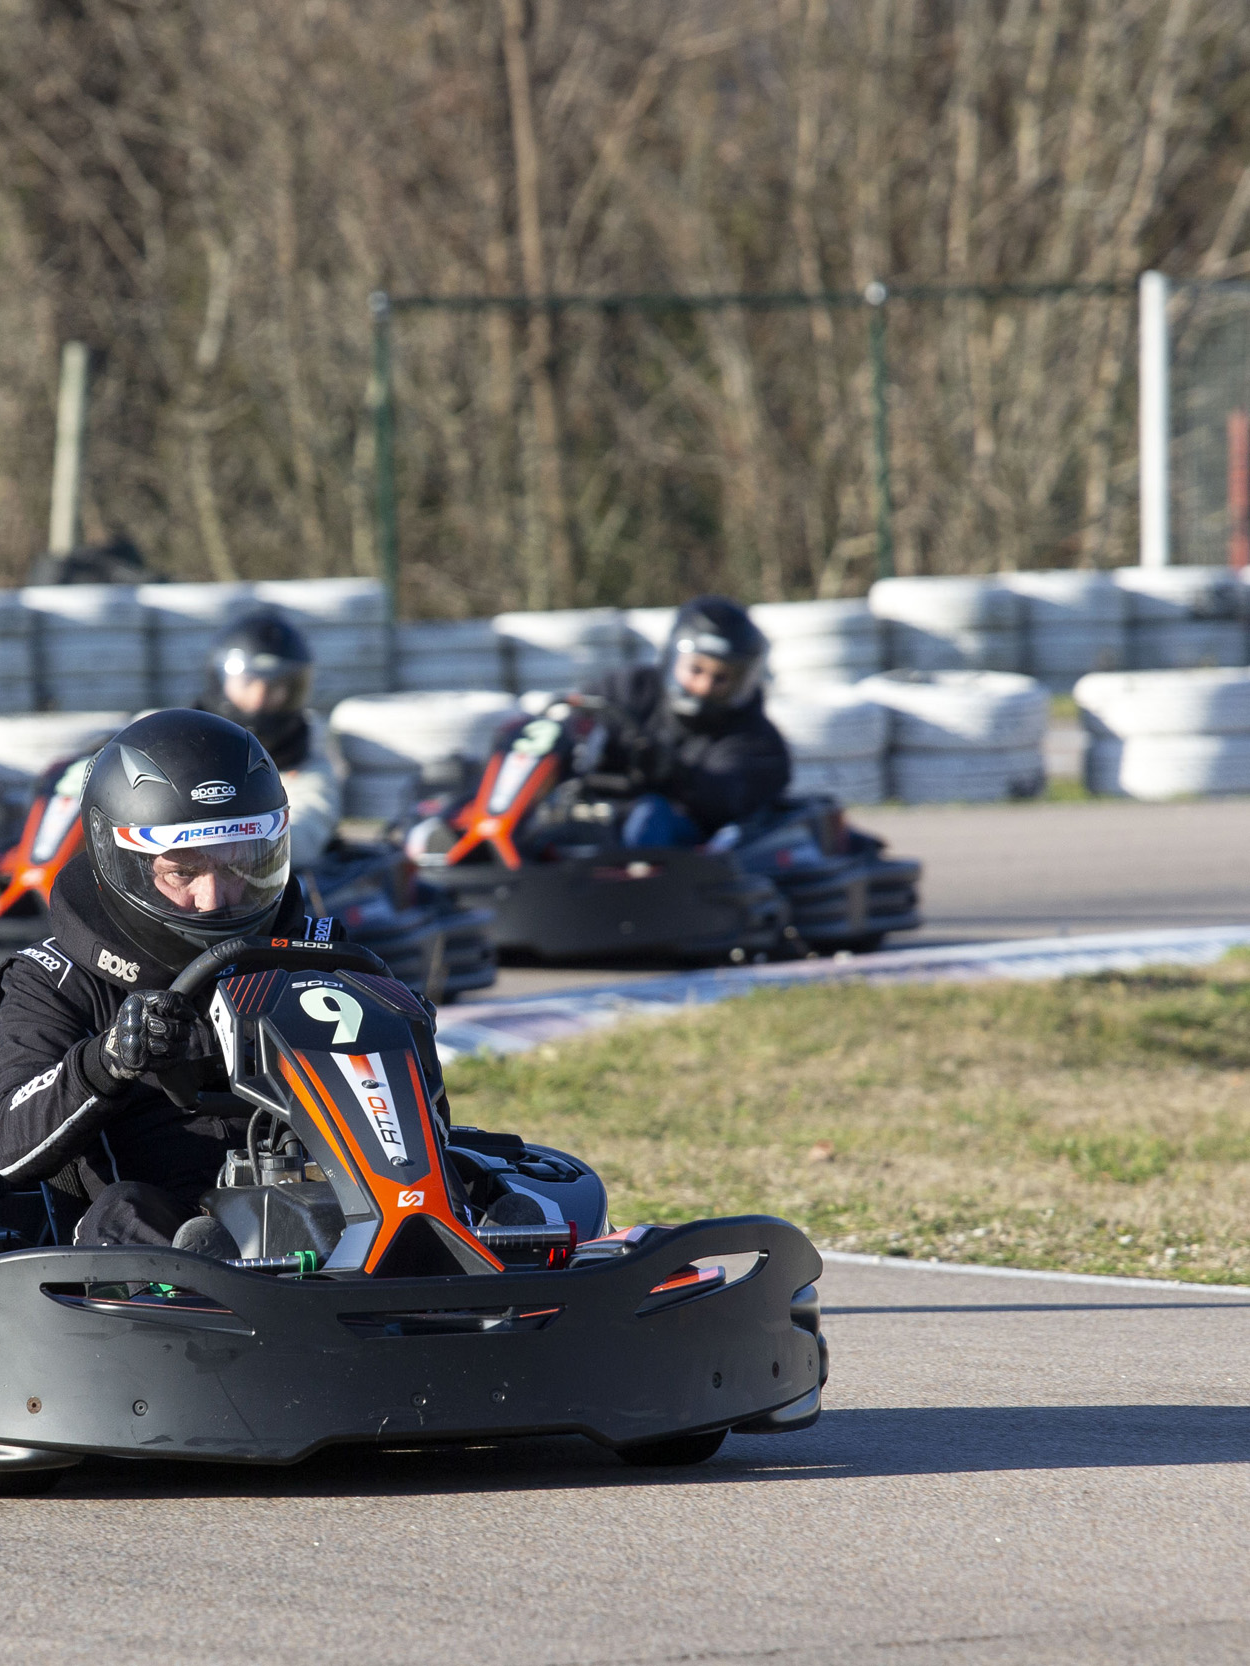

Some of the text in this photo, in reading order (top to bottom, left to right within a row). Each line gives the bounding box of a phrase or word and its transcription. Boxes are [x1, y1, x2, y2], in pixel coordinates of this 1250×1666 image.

[291, 940, 334, 950] SODI
[291, 980, 344, 989] SODI
[299, 987, 364, 1044] 9
